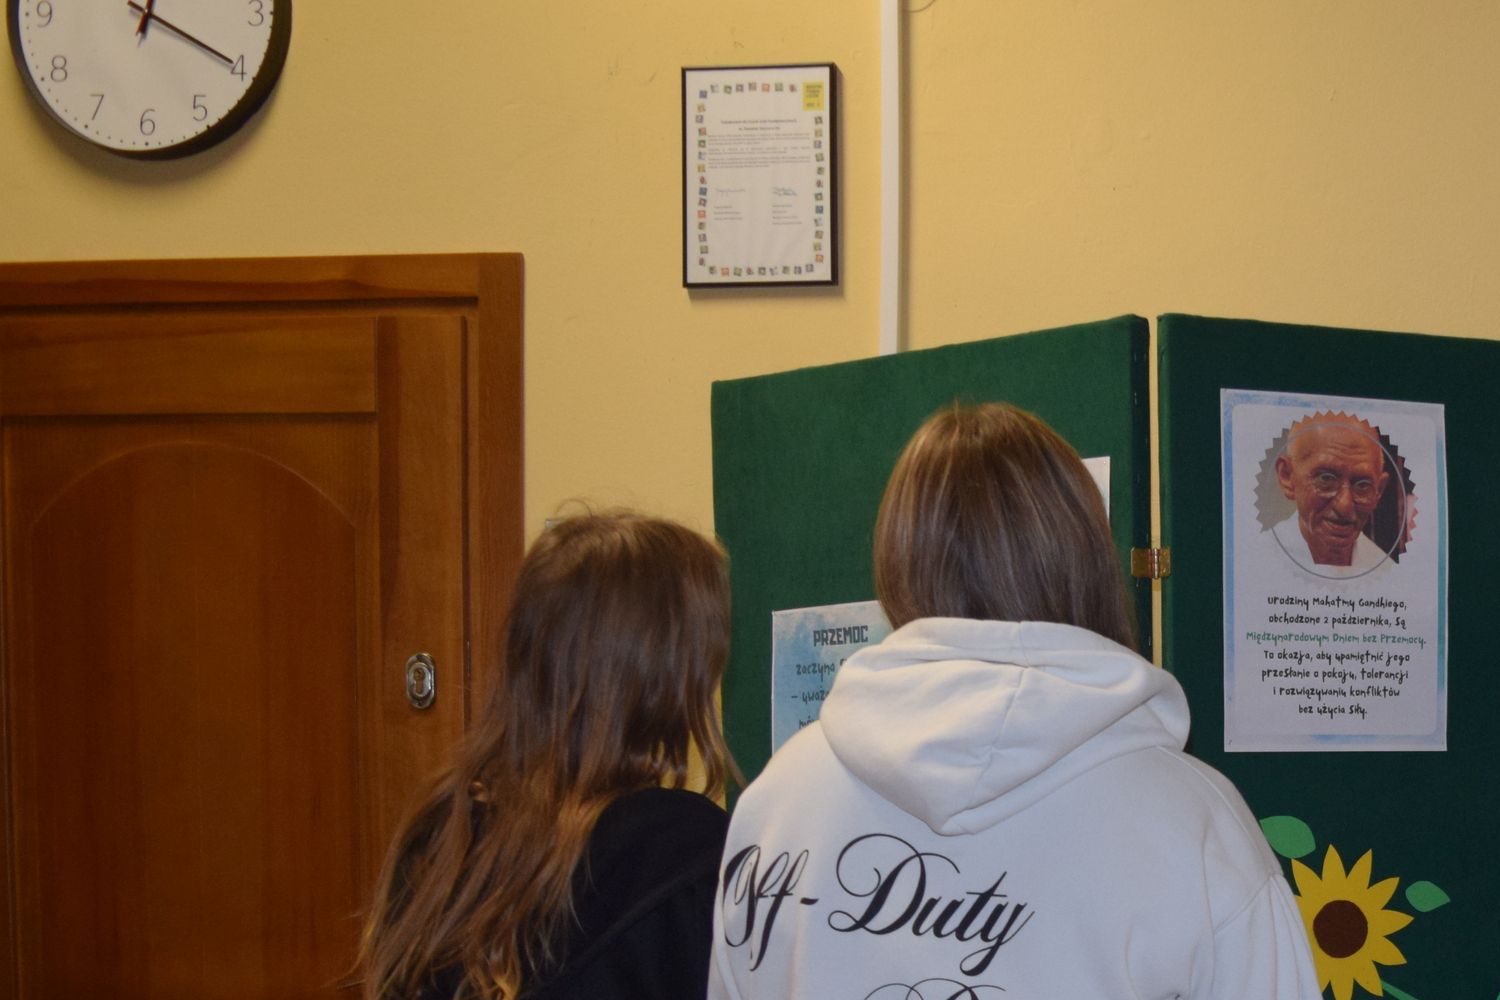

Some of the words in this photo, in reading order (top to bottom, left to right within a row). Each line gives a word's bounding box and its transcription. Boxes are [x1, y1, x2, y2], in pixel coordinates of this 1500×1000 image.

[37, 0, 53, 26] 9
[248, 0, 264, 26] 3
[50, 56, 68, 81] 8
[231, 53, 246, 80] 4
[91, 94, 104, 120] 7
[193, 95, 207, 121] 5
[140, 109, 155, 135] 6
[813, 625, 868, 646] PRZEMOC
[795, 663, 835, 682] zaczyna
